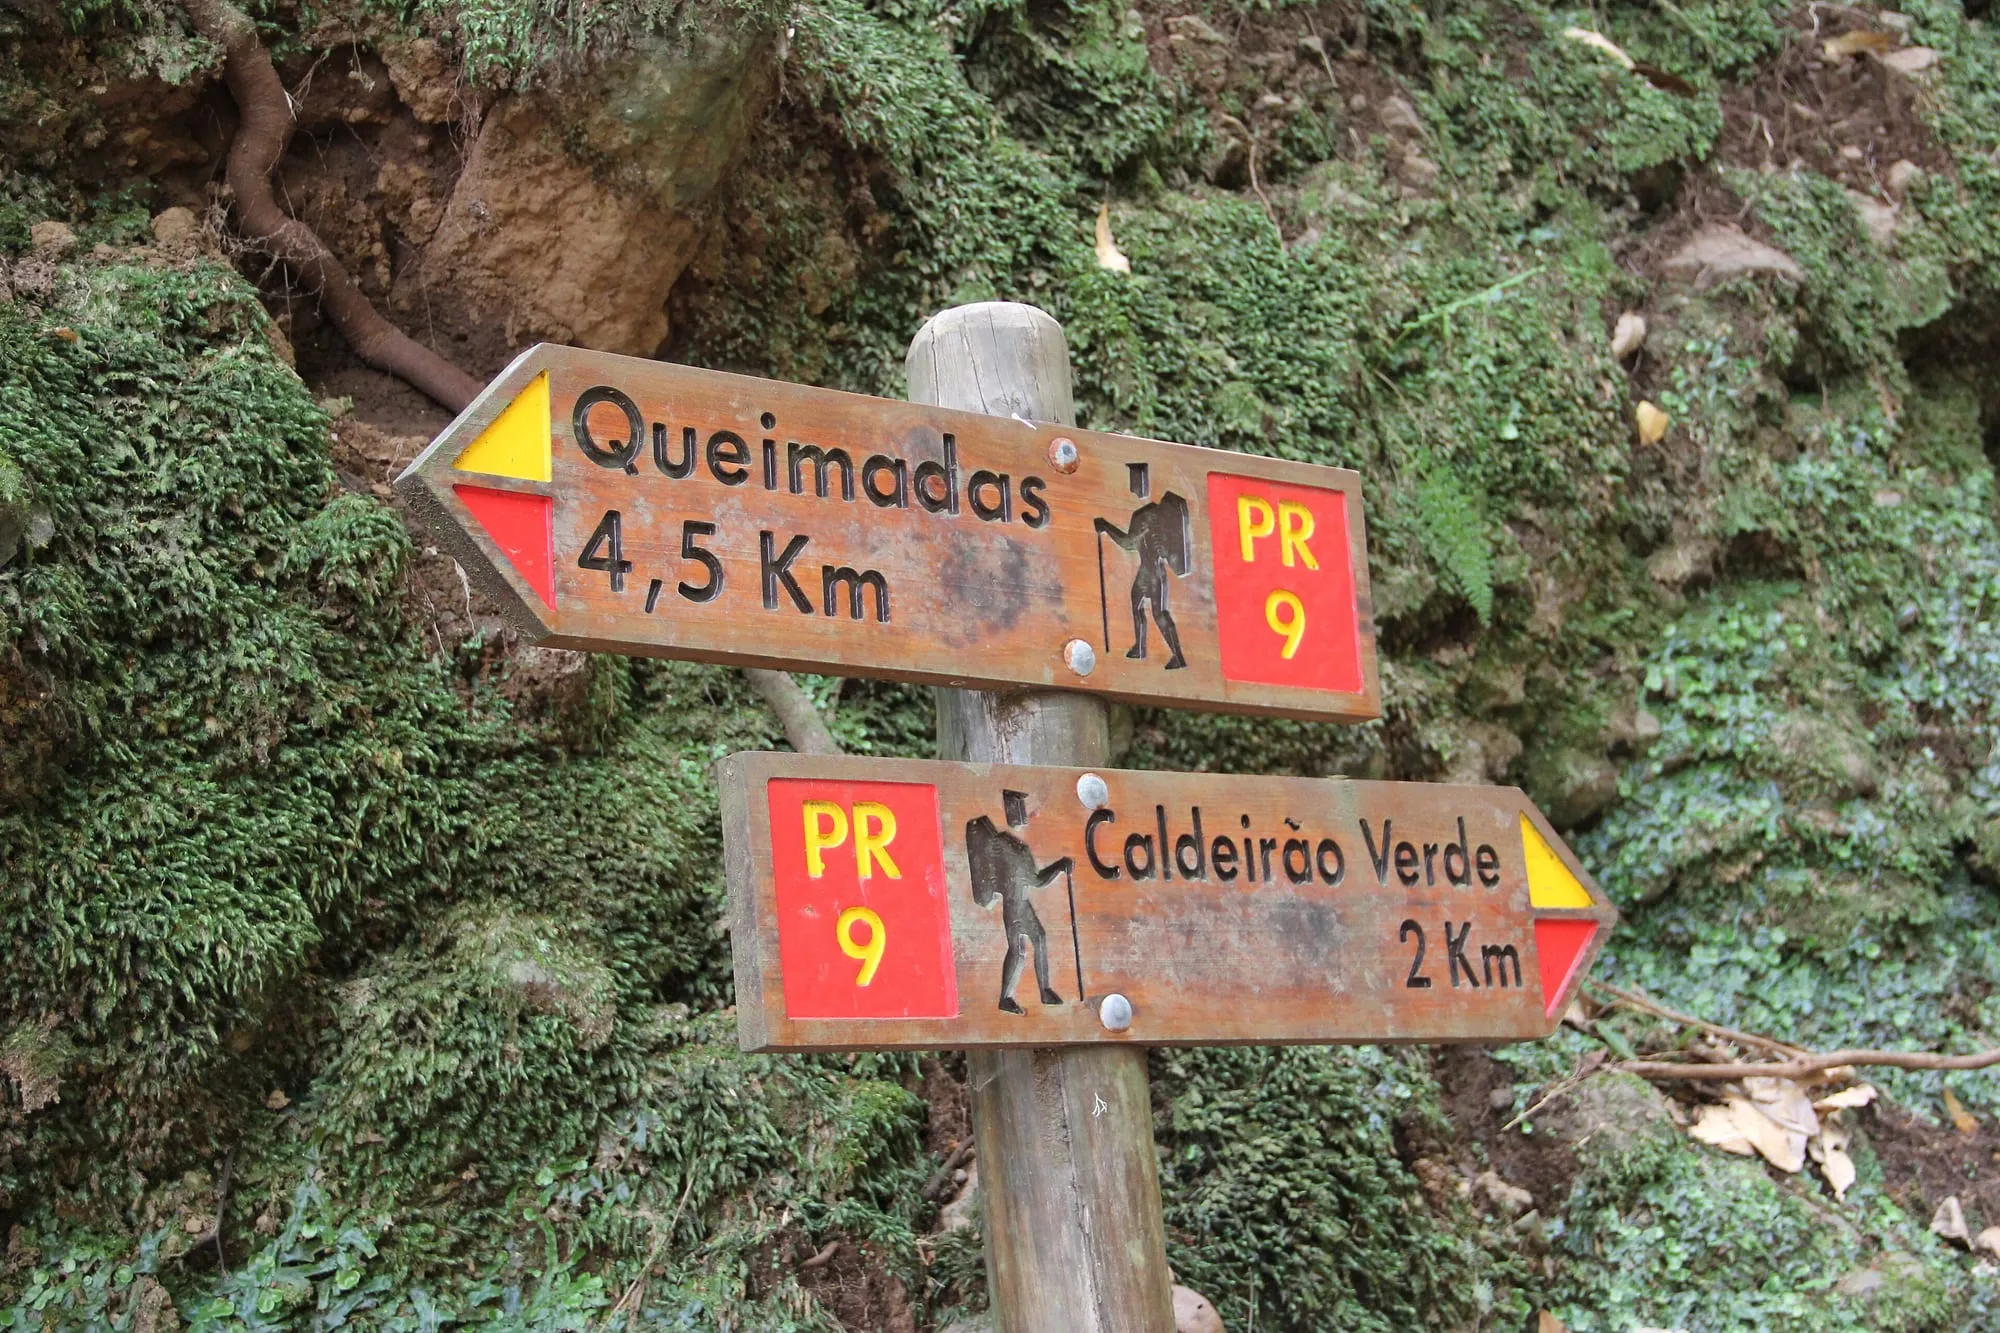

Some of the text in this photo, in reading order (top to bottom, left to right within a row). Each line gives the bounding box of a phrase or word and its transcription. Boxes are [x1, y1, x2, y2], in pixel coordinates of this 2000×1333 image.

[573, 385, 1051, 529] Queimadas
[1237, 493, 1320, 571] PR
[760, 530, 891, 624] Km
[1264, 588, 1306, 660] 9
[802, 799, 902, 879] PR
[1085, 804, 1501, 888] Caldeirão Verde
[836, 906, 886, 987] 9
[1400, 918, 1523, 988] 2 Km
